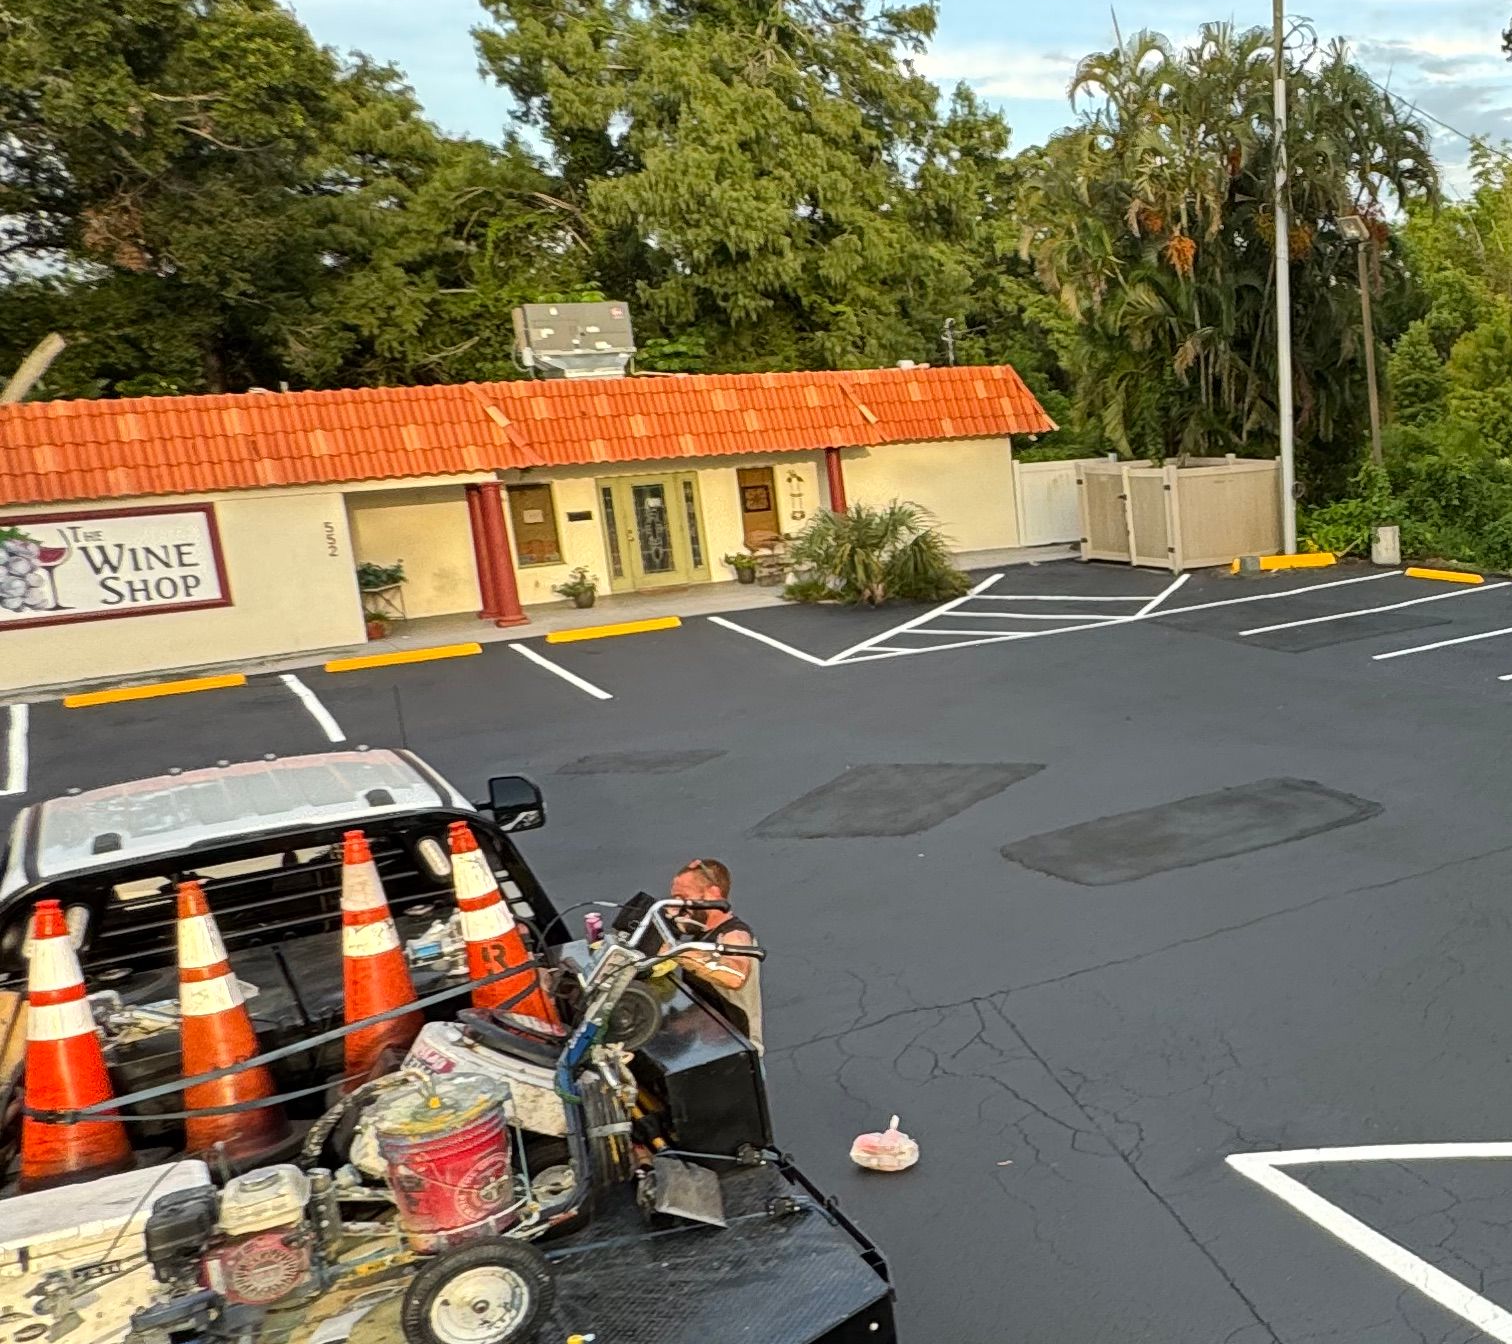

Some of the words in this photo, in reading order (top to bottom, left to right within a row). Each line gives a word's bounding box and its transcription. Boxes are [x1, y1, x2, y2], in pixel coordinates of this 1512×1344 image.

[323, 521, 340, 557] 552
[78, 543, 200, 575] WINE
[100, 574, 201, 605] SHOP
